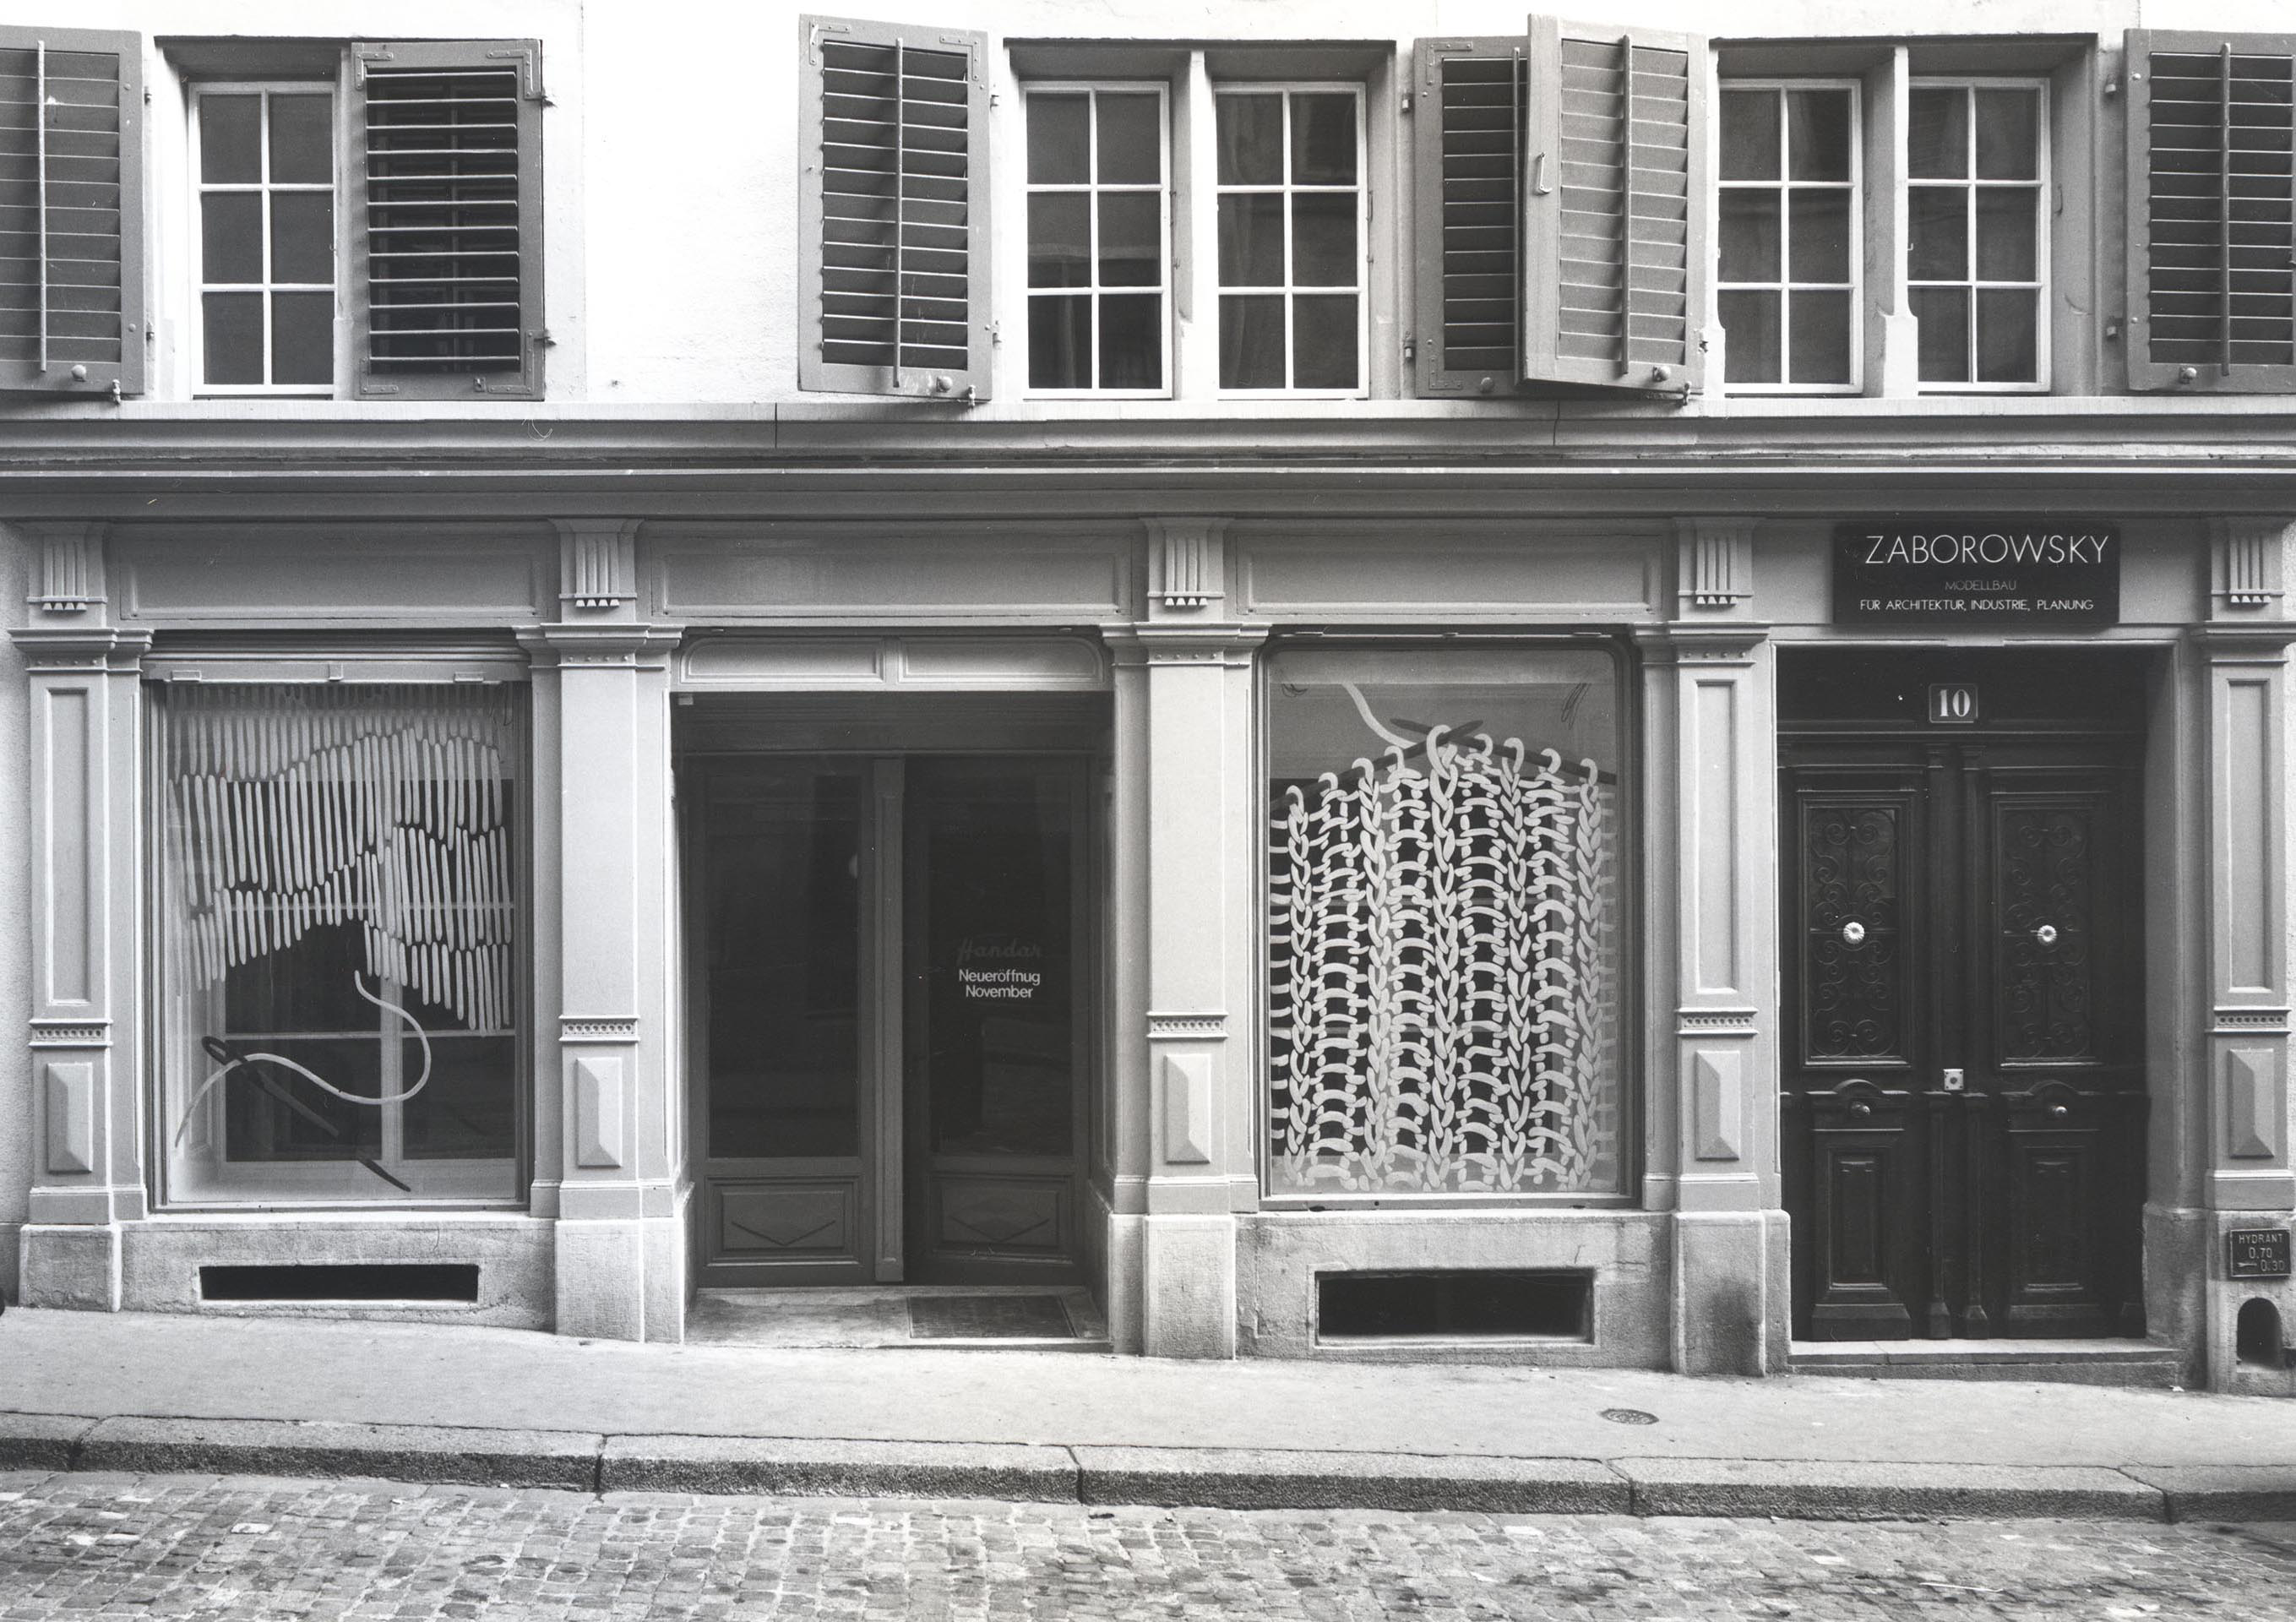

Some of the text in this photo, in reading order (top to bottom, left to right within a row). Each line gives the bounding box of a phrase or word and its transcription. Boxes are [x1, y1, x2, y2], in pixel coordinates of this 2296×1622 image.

[1865, 534, 2109, 564] ZABOROWSKY
[1945, 580, 2017, 591] MODELLBAU
[1885, 599, 1967, 612] ARCHITEKTUR,
[1971, 599, 2031, 612] INDUSTRIE,
[2037, 599, 2094, 610] PLANUNG
[1939, 689, 1971, 717] 10
[959, 968, 1041, 986] Neueröffnug
[966, 984, 1034, 999] November
[2239, 1233, 2283, 1244] HYDRANT
[2249, 1246, 2272, 1259] 0.70
